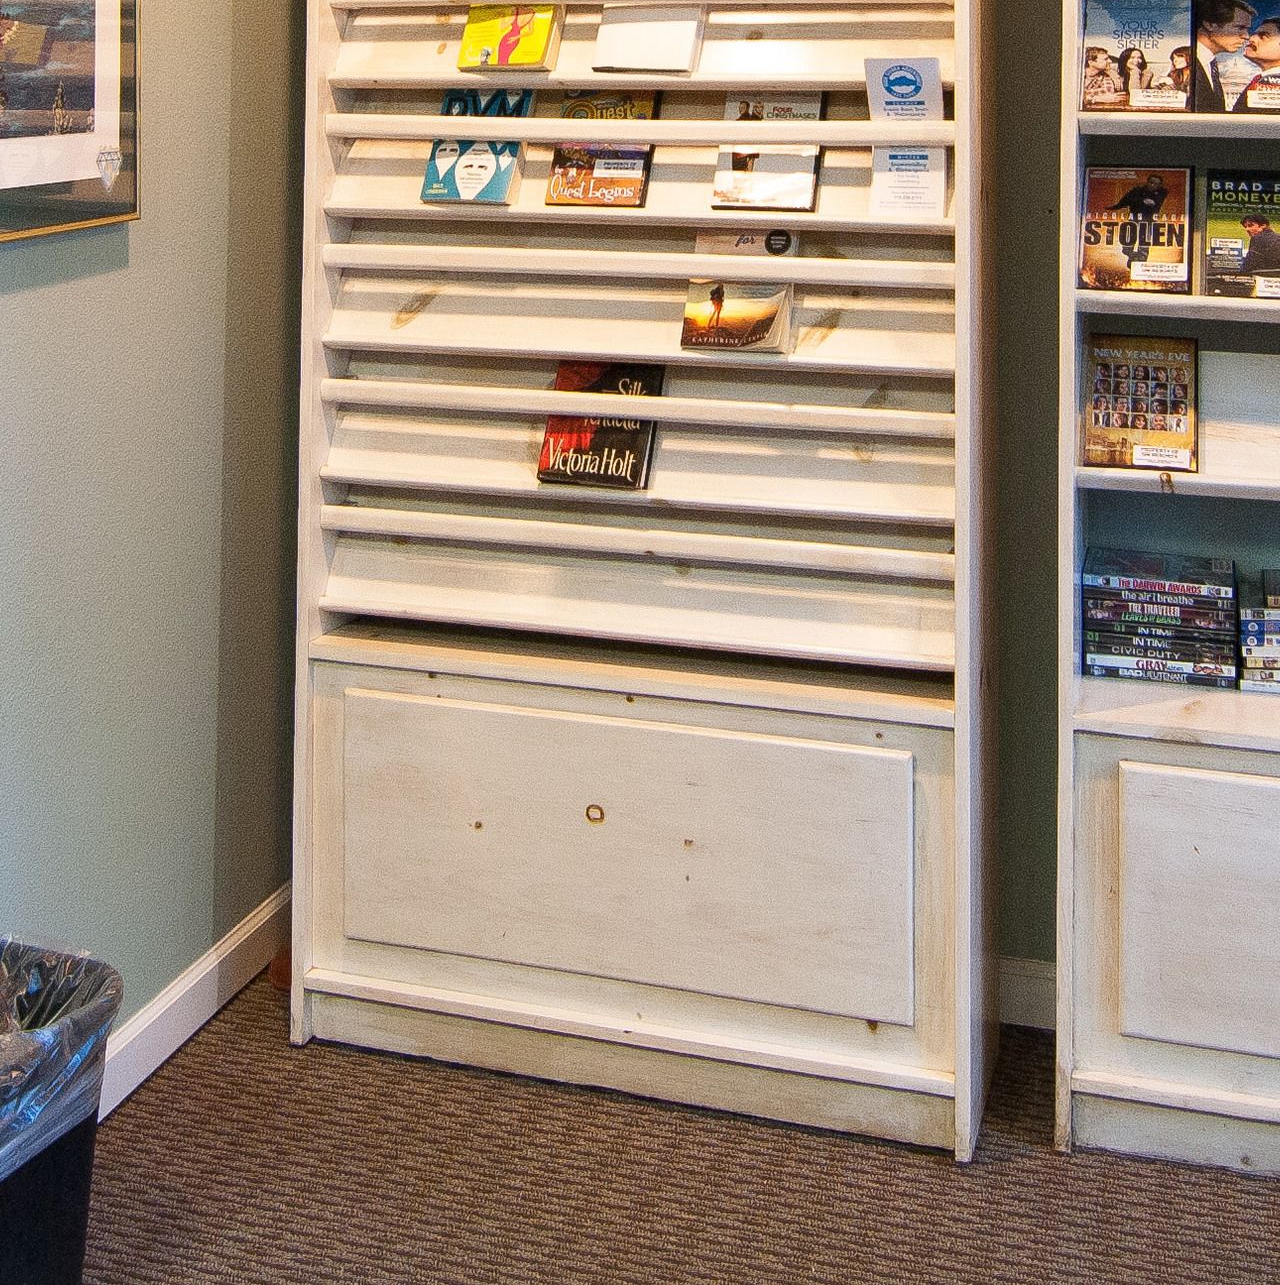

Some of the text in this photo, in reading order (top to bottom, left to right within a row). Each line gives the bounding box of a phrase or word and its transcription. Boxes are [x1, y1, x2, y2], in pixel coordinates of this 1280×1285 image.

[1120, 19, 1157, 31] YOUR
[1112, 30, 1166, 41] SISTER'S
[1117, 39, 1160, 50] SISTER
[550, 174, 585, 200] Quest
[1211, 181, 1264, 192] BRAD
[1084, 220, 1186, 247] STOLEN
[735, 234, 756, 248] for
[692, 336, 739, 344] KATHERINE
[618, 378, 647, 396] Silk
[546, 436, 637, 482] Victoria Holt
[1132, 579, 1167, 591] DARWIN
[1168, 583, 1201, 595] AWARDS
[1121, 590, 1137, 600] the
[1127, 602, 1142, 613] THE
[1138, 626, 1176, 636] IN TIME
[1132, 636, 1171, 648] IN TIME
[1111, 645, 1181, 660] CIVIC DUTY
[1135, 659, 1168, 671] GRAY
